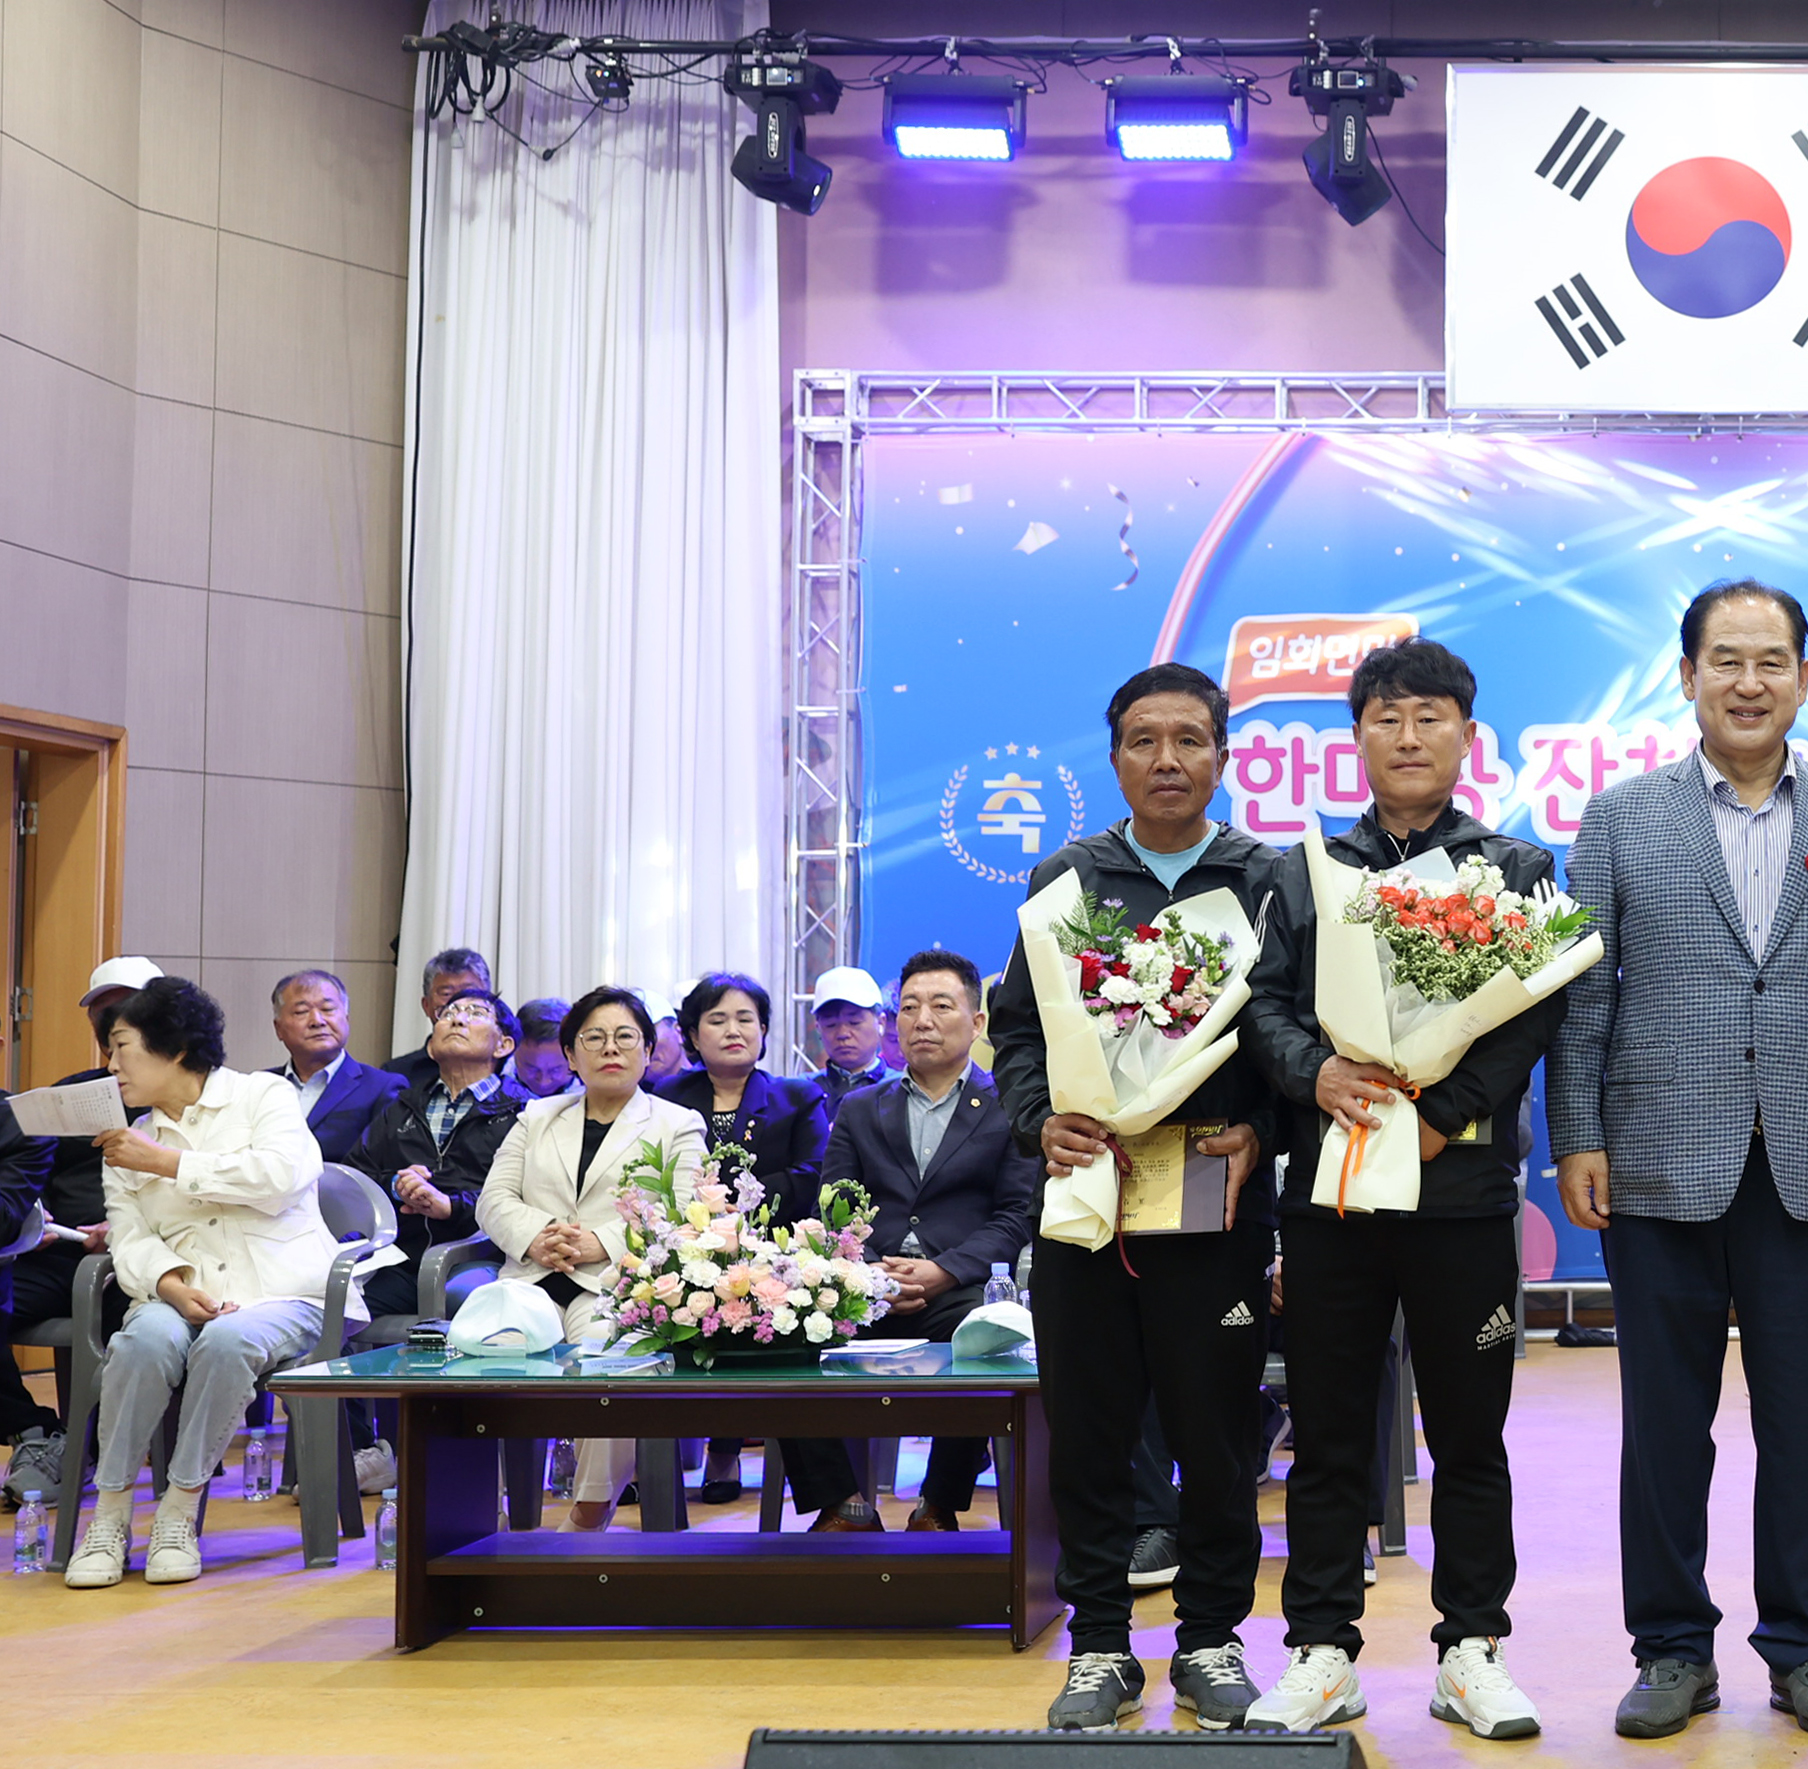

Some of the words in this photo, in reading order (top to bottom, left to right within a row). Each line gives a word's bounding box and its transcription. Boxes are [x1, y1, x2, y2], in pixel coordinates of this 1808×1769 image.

[977, 772, 1046, 853] 축
[1221, 1316, 1254, 1326] adidas
[1476, 1322, 1516, 1344] adidas
